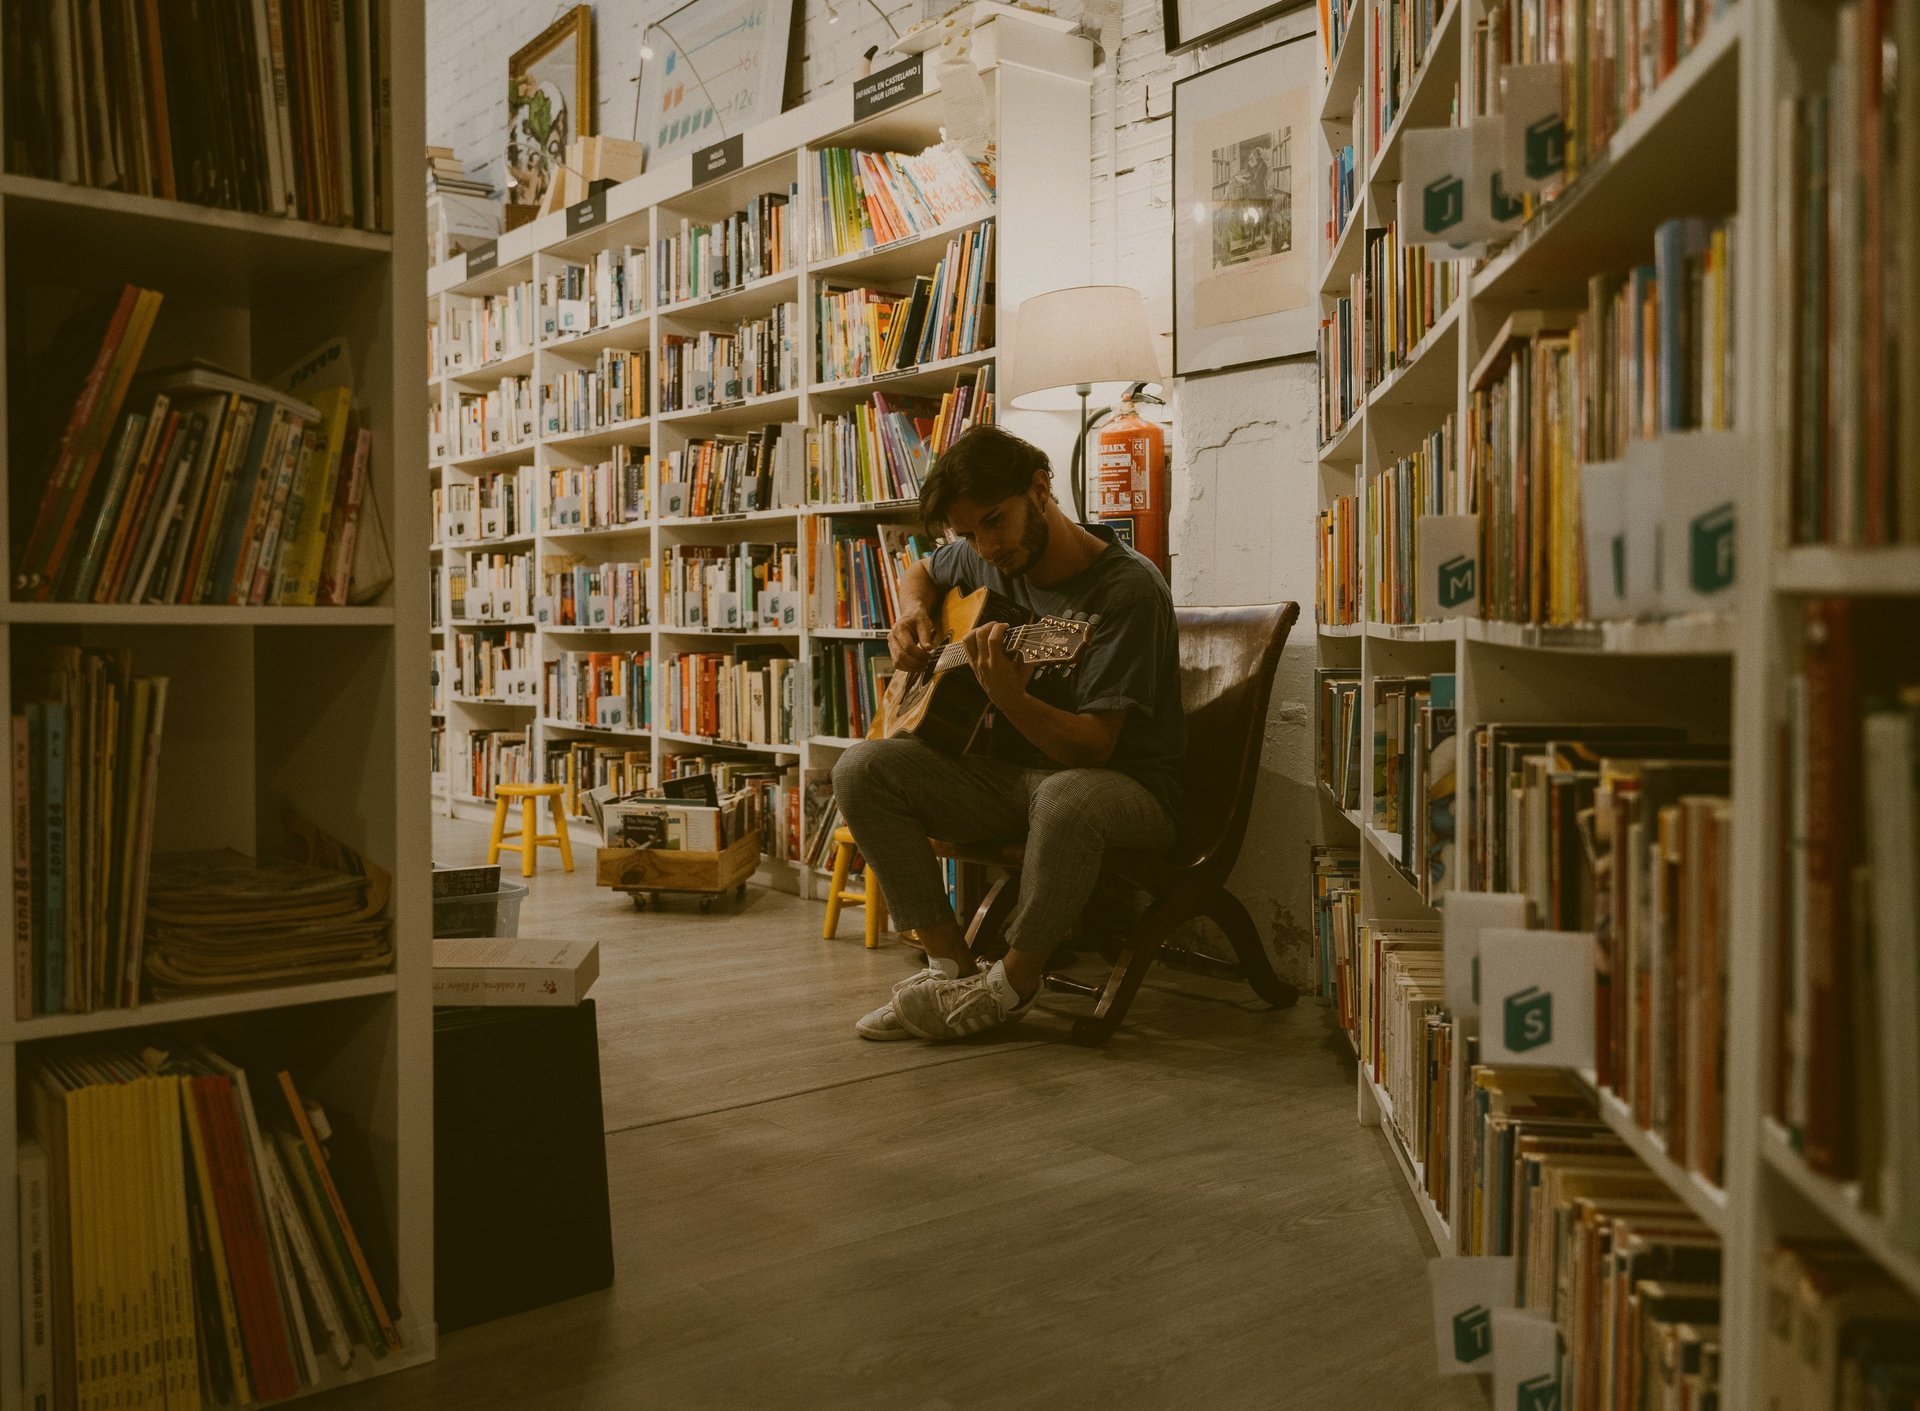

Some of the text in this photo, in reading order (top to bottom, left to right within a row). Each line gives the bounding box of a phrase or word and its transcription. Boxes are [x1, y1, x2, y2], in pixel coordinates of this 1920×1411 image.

[855, 84, 877, 100] INFANTIL
[877, 81, 885, 91] EN
[885, 67, 917, 87] CASTELLANO
[870, 91, 884, 104] HAUR
[1546, 134, 1562, 164] L
[1440, 191, 1455, 221] J
[1449, 570, 1473, 600] M
[16, 896, 28, 942] zona
[1522, 1010, 1545, 1041] S
[1470, 1320, 1487, 1349] T
